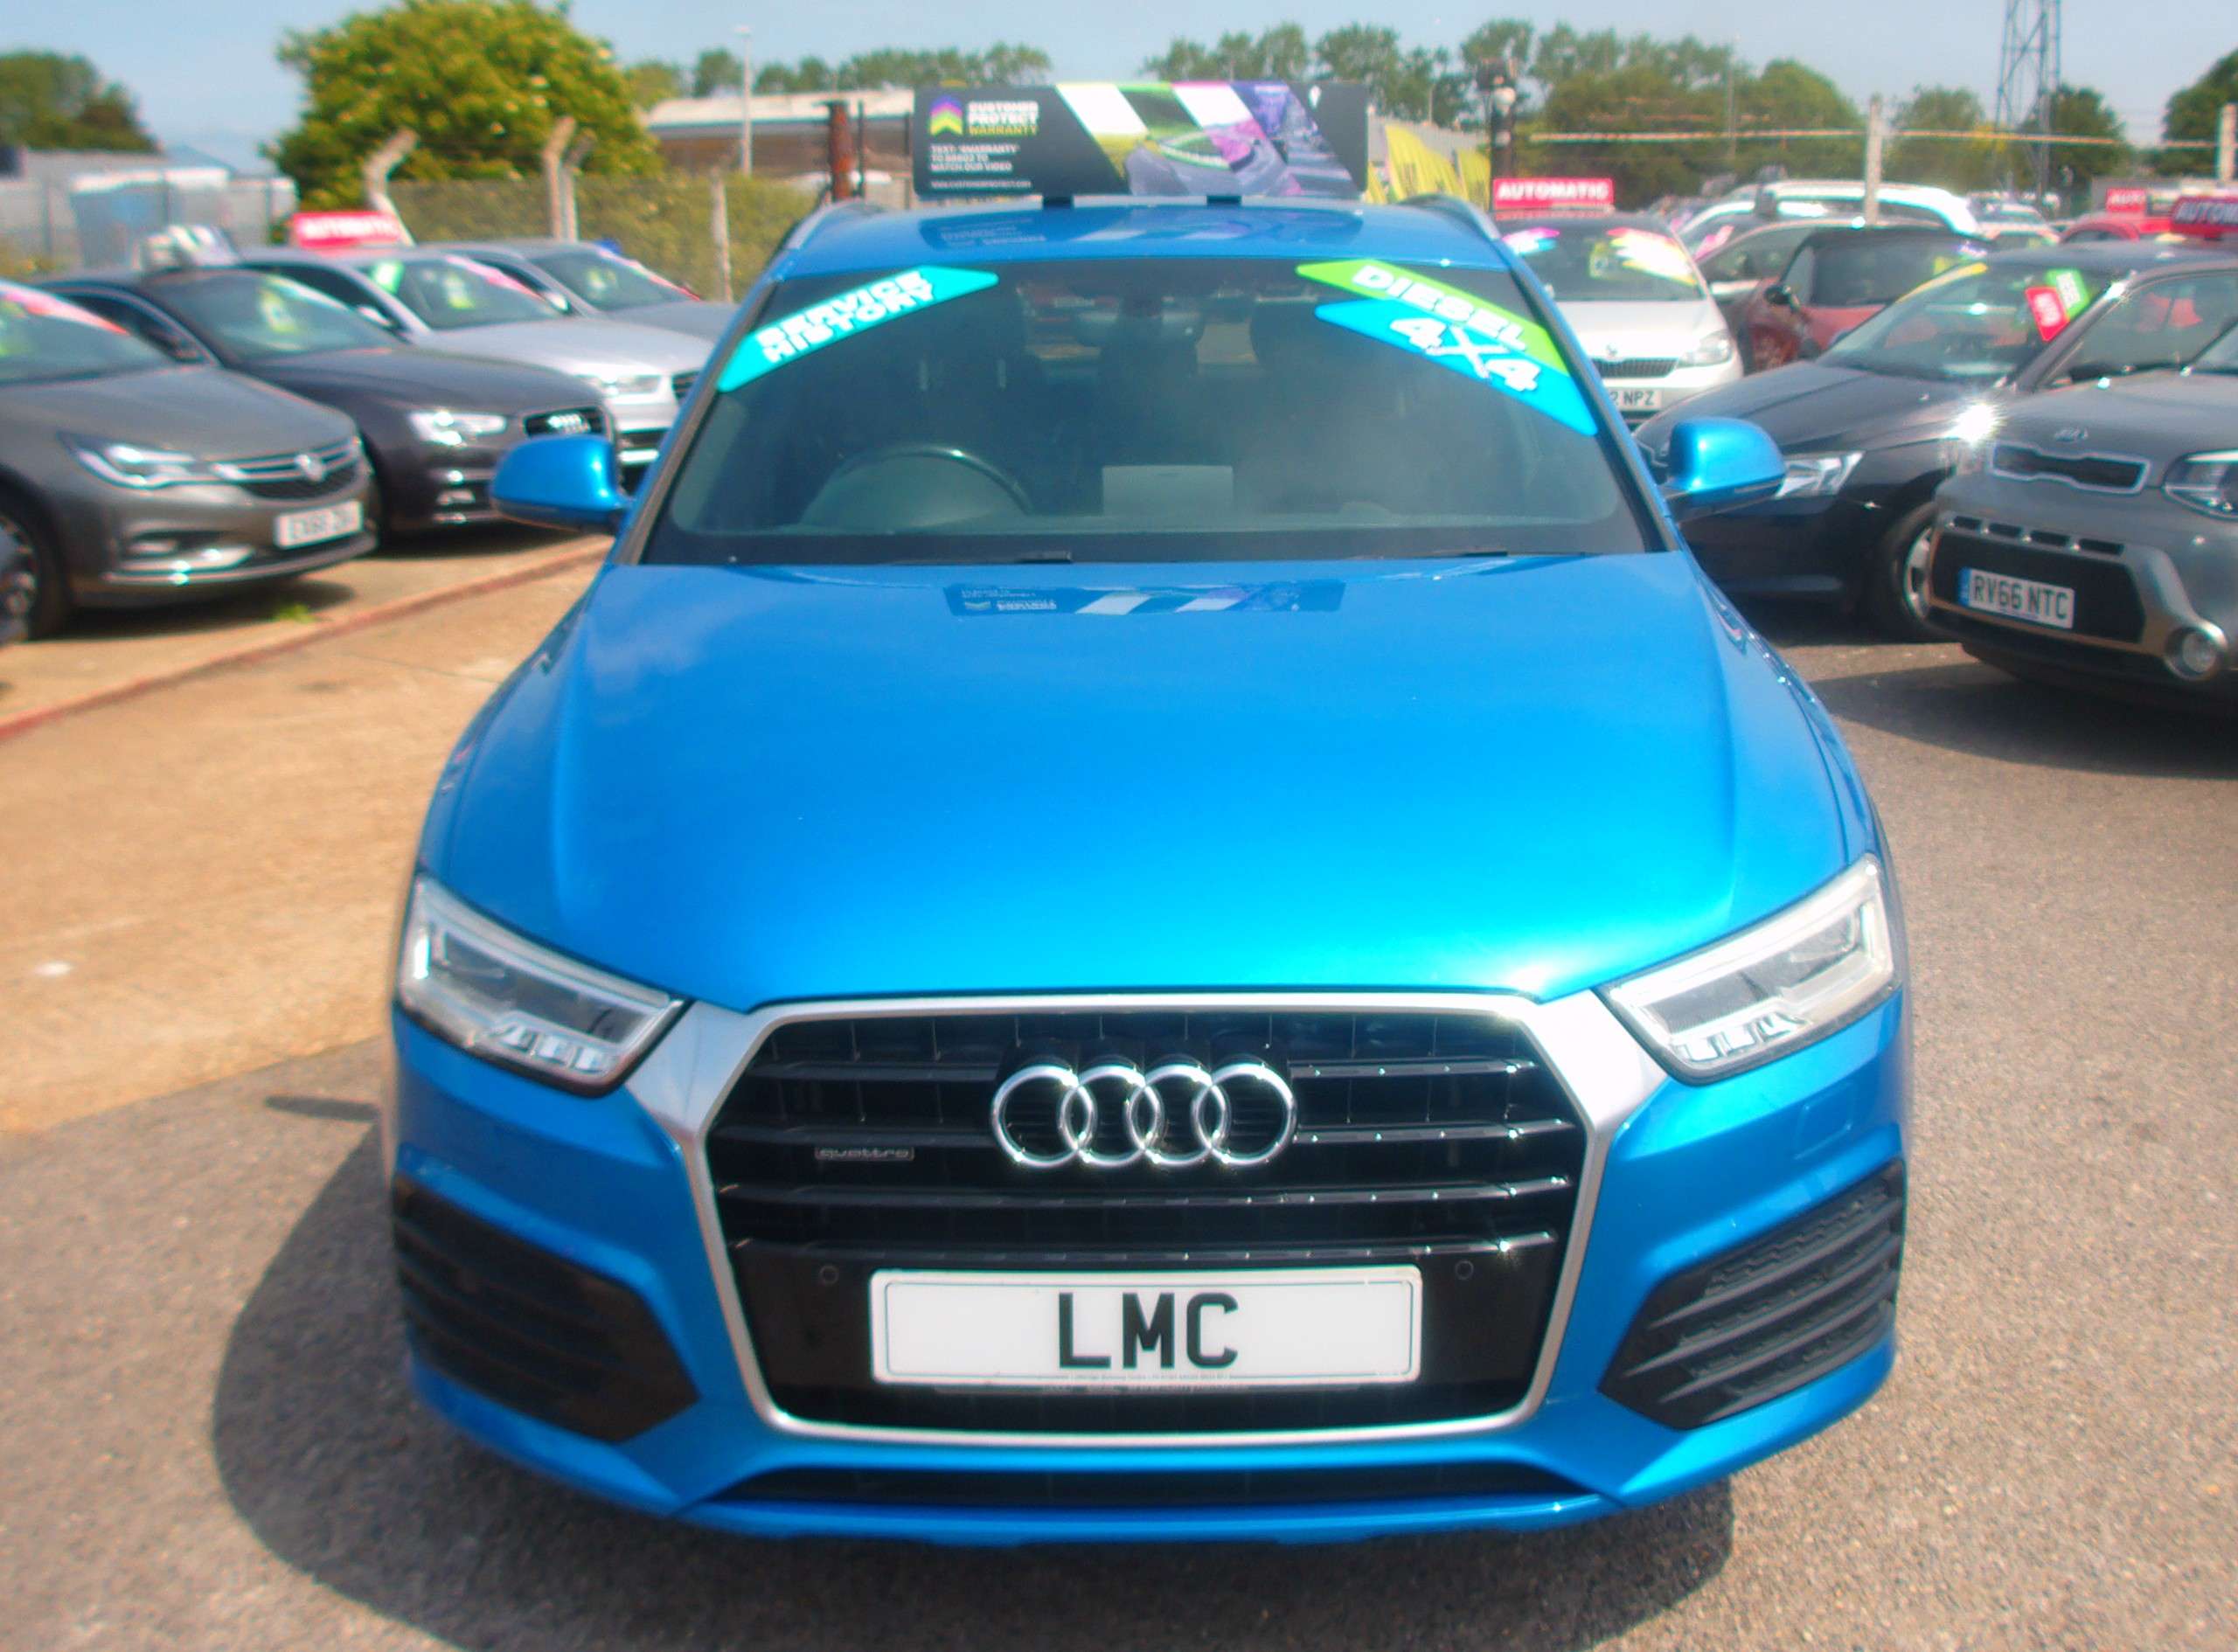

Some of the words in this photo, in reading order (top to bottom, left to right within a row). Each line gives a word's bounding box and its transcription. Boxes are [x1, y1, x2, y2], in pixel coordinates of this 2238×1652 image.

[1498, 181, 1609, 200] AUTOMATIC
[1352, 265, 1526, 351] DIESEL
[1389, 316, 1541, 392] 4X4
[1623, 390, 1655, 406] NPZ
[1973, 574, 2023, 611] RV66
[2028, 585, 2068, 621] NTC
[1059, 1292, 1239, 1370] LMC
